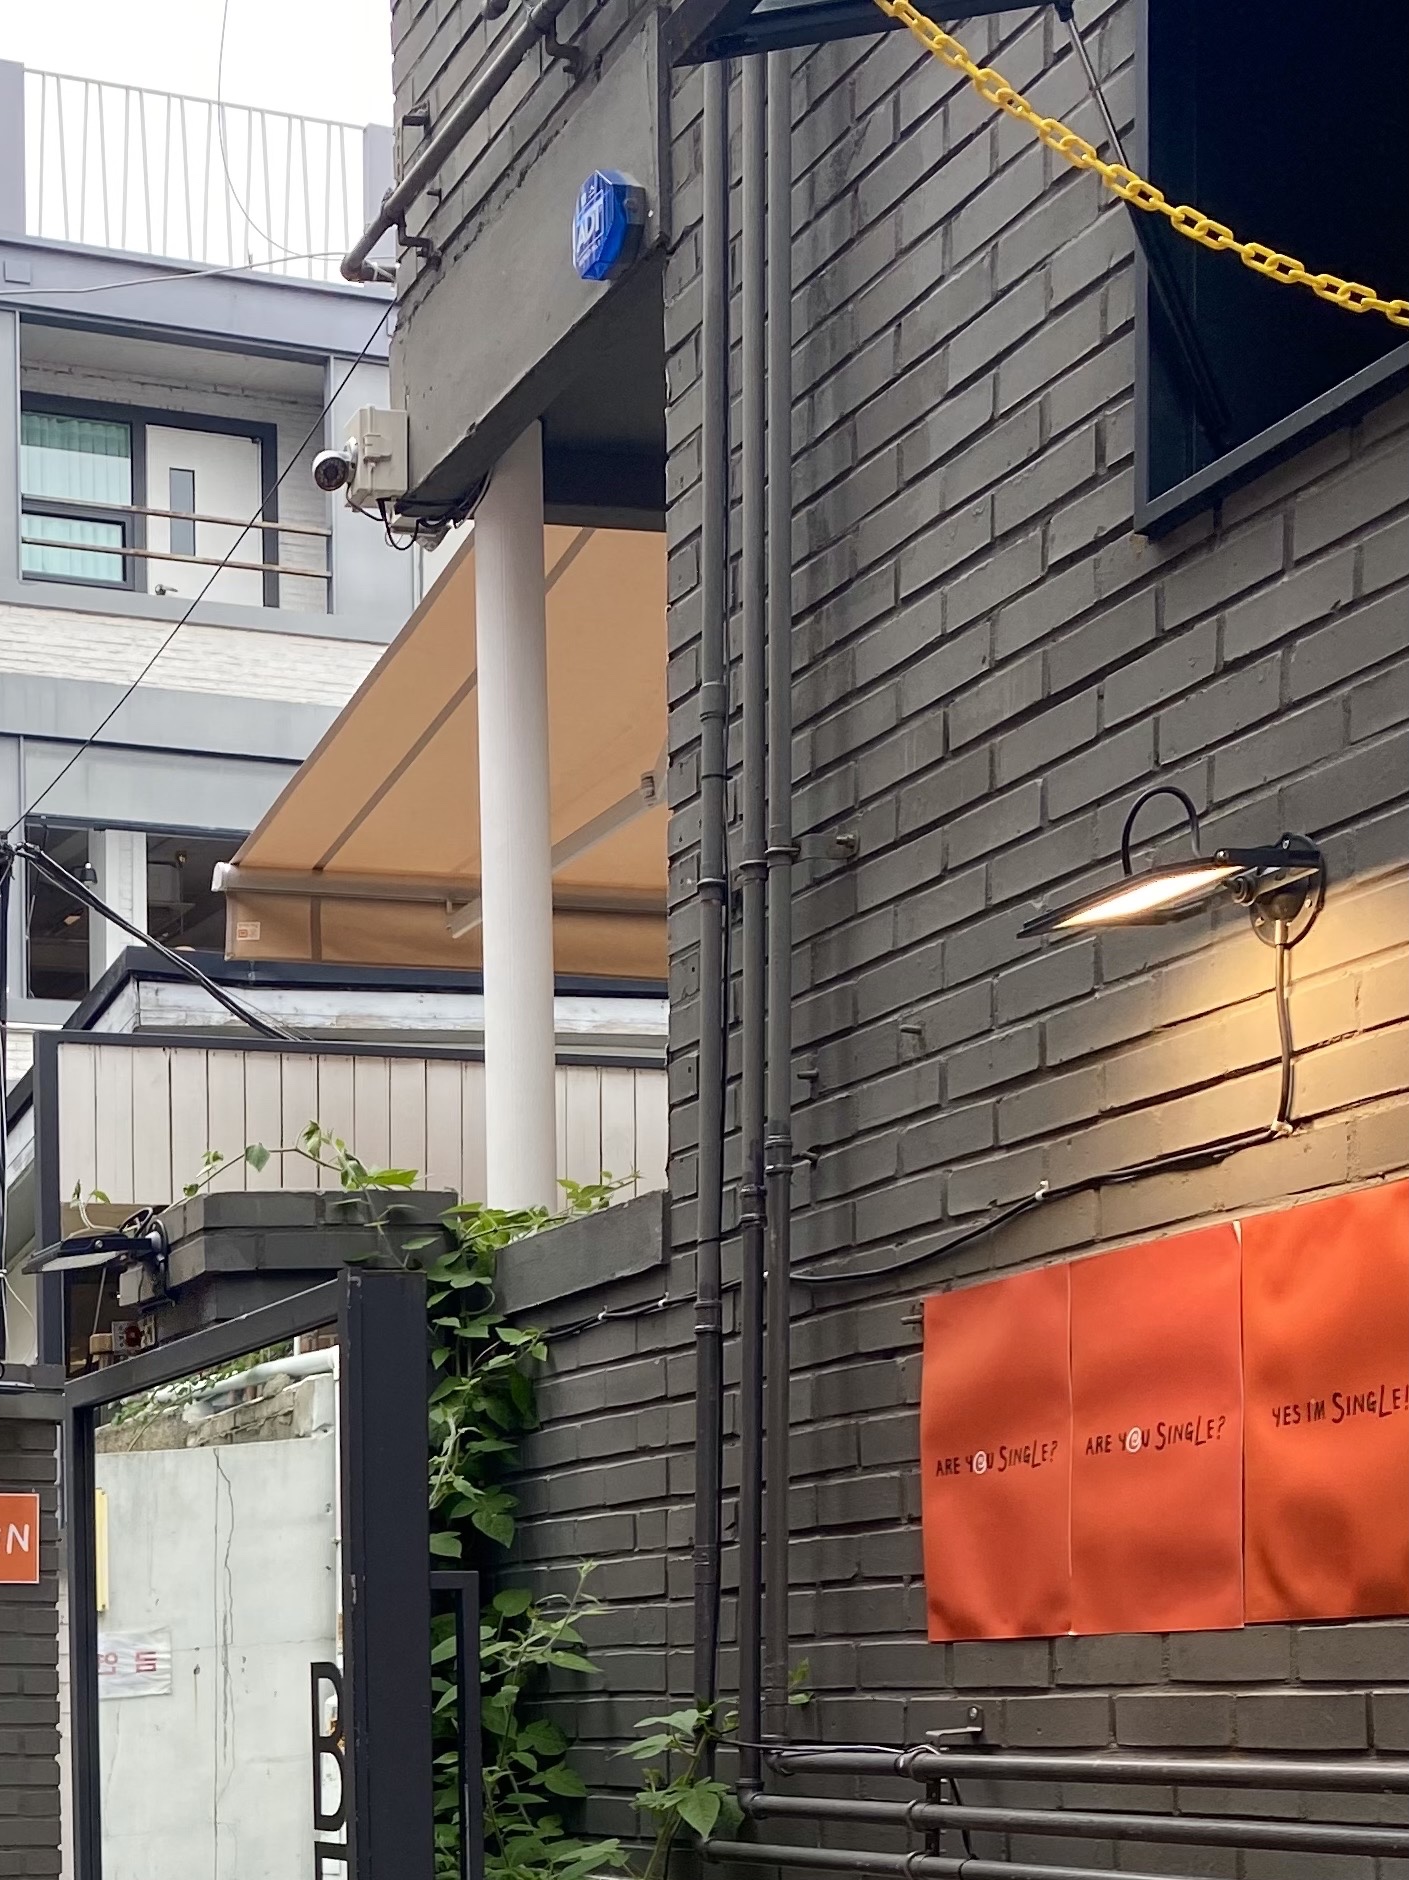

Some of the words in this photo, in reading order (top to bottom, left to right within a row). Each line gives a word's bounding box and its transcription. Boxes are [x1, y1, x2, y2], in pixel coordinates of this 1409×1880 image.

[576, 196, 604, 254] ADT
[1085, 1434, 1112, 1455] ARE
[1155, 1415, 1226, 1451] SINGLE?
[1272, 1404, 1301, 1427] YES
[936, 1457, 960, 1477] ARE
[997, 1439, 1058, 1472] SINGLE?
